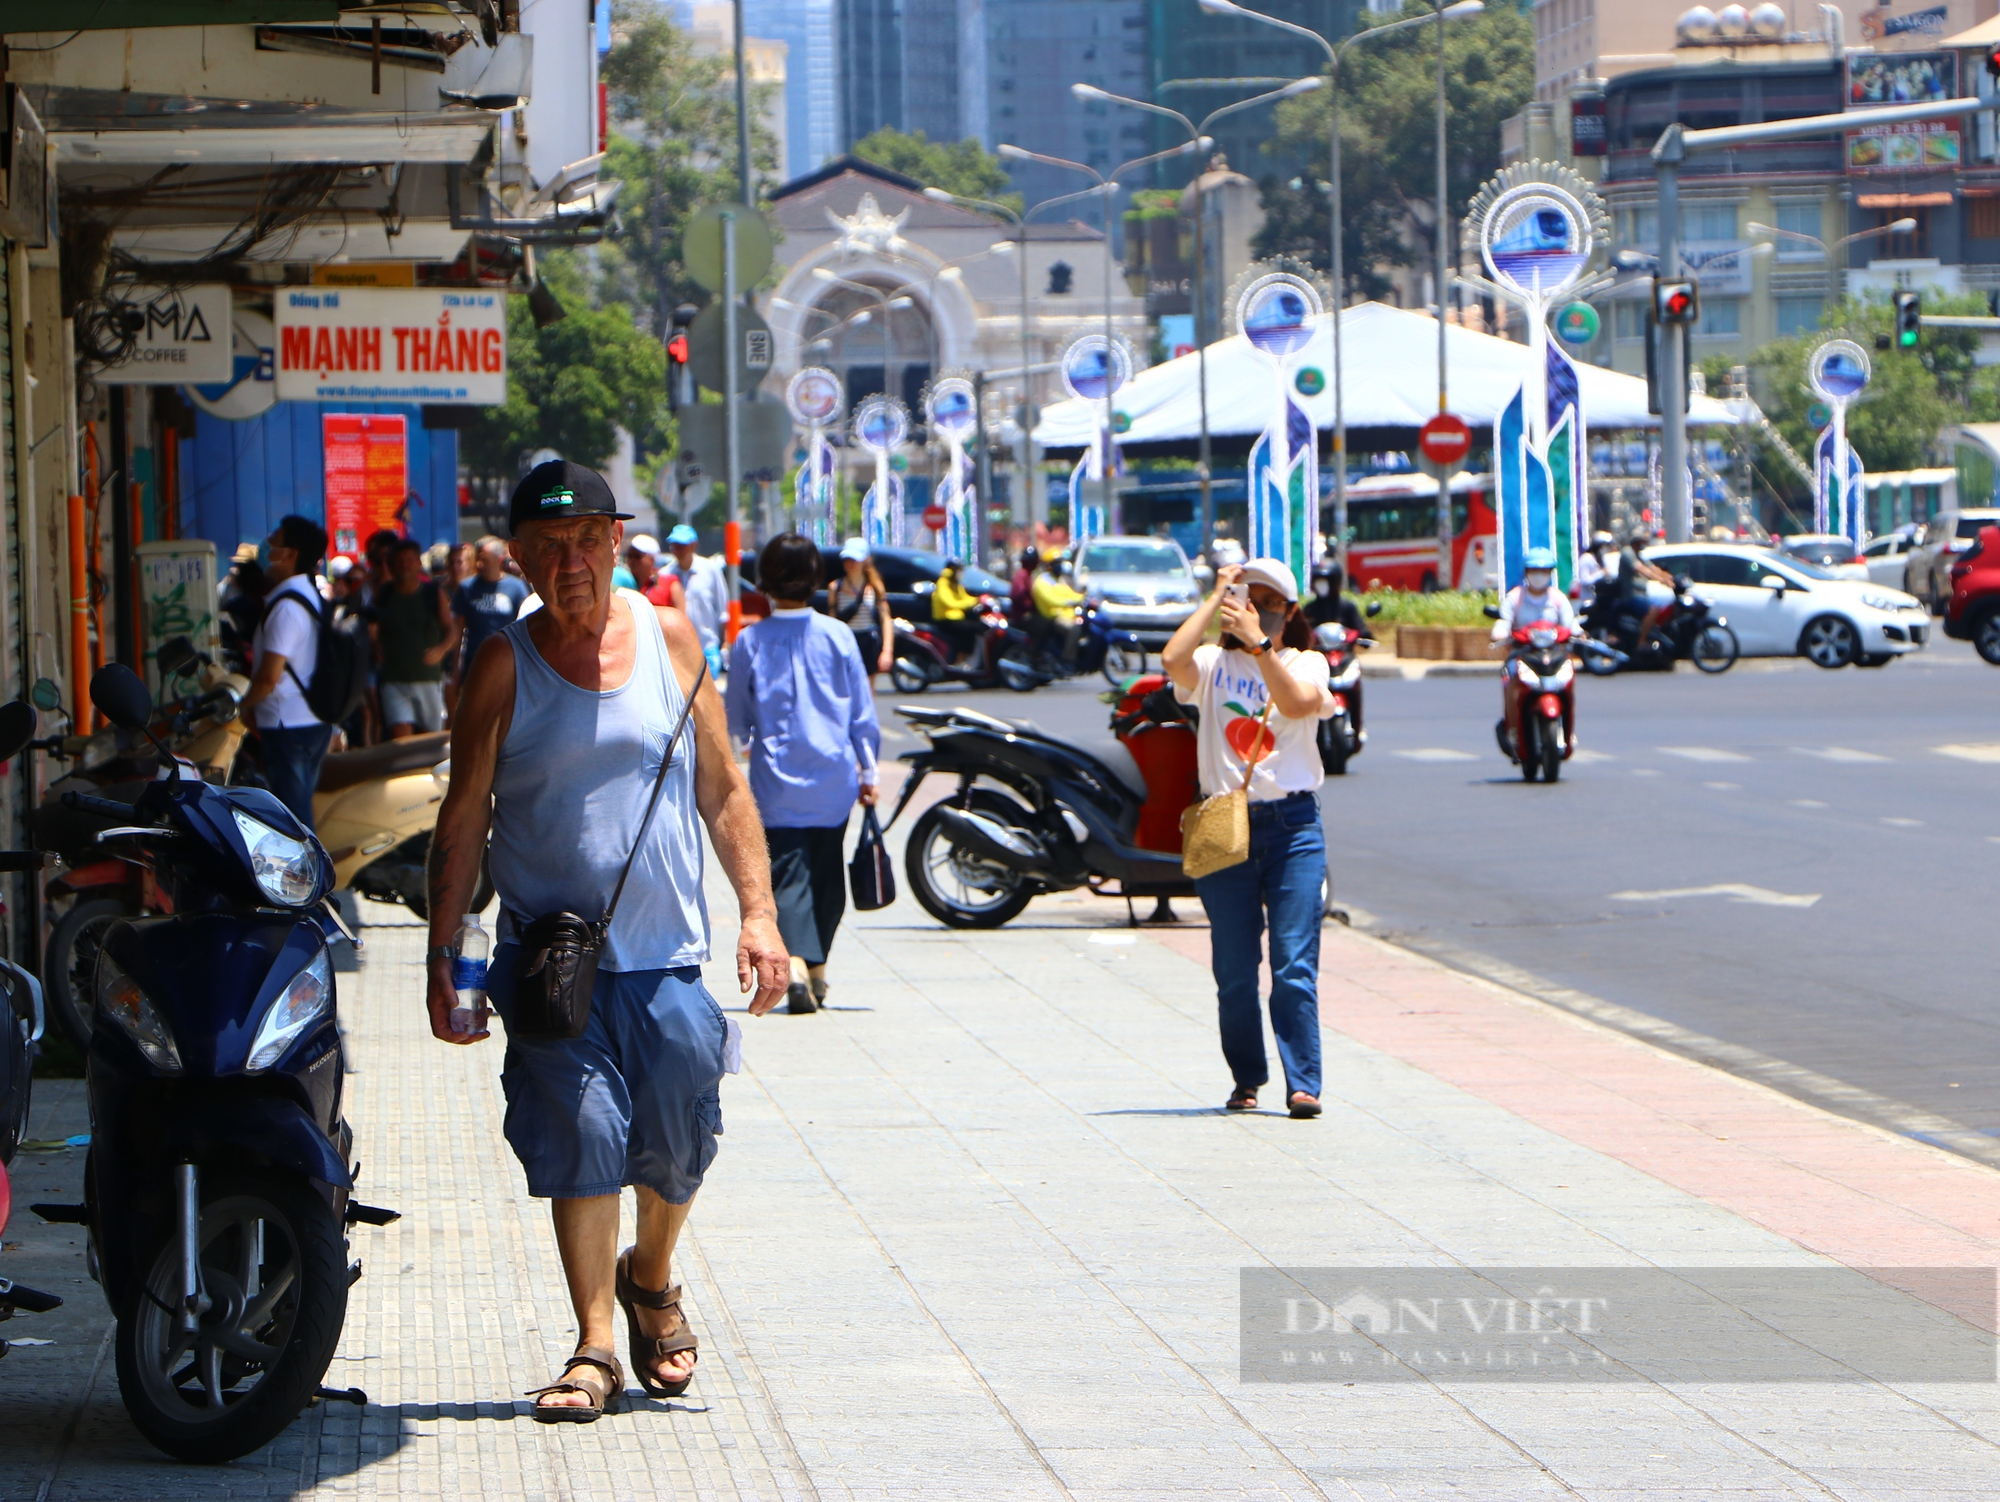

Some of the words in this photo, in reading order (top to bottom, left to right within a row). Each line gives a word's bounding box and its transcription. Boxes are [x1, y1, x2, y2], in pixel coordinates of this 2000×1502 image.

[326, 272, 378, 286] Western
[281, 325, 381, 380] MẠNH
[392, 309, 502, 373] THẮNG
[134, 348, 187, 363] COFFEE
[541, 496, 560, 505] ROCK
[308, 1047, 338, 1073] HONDA
